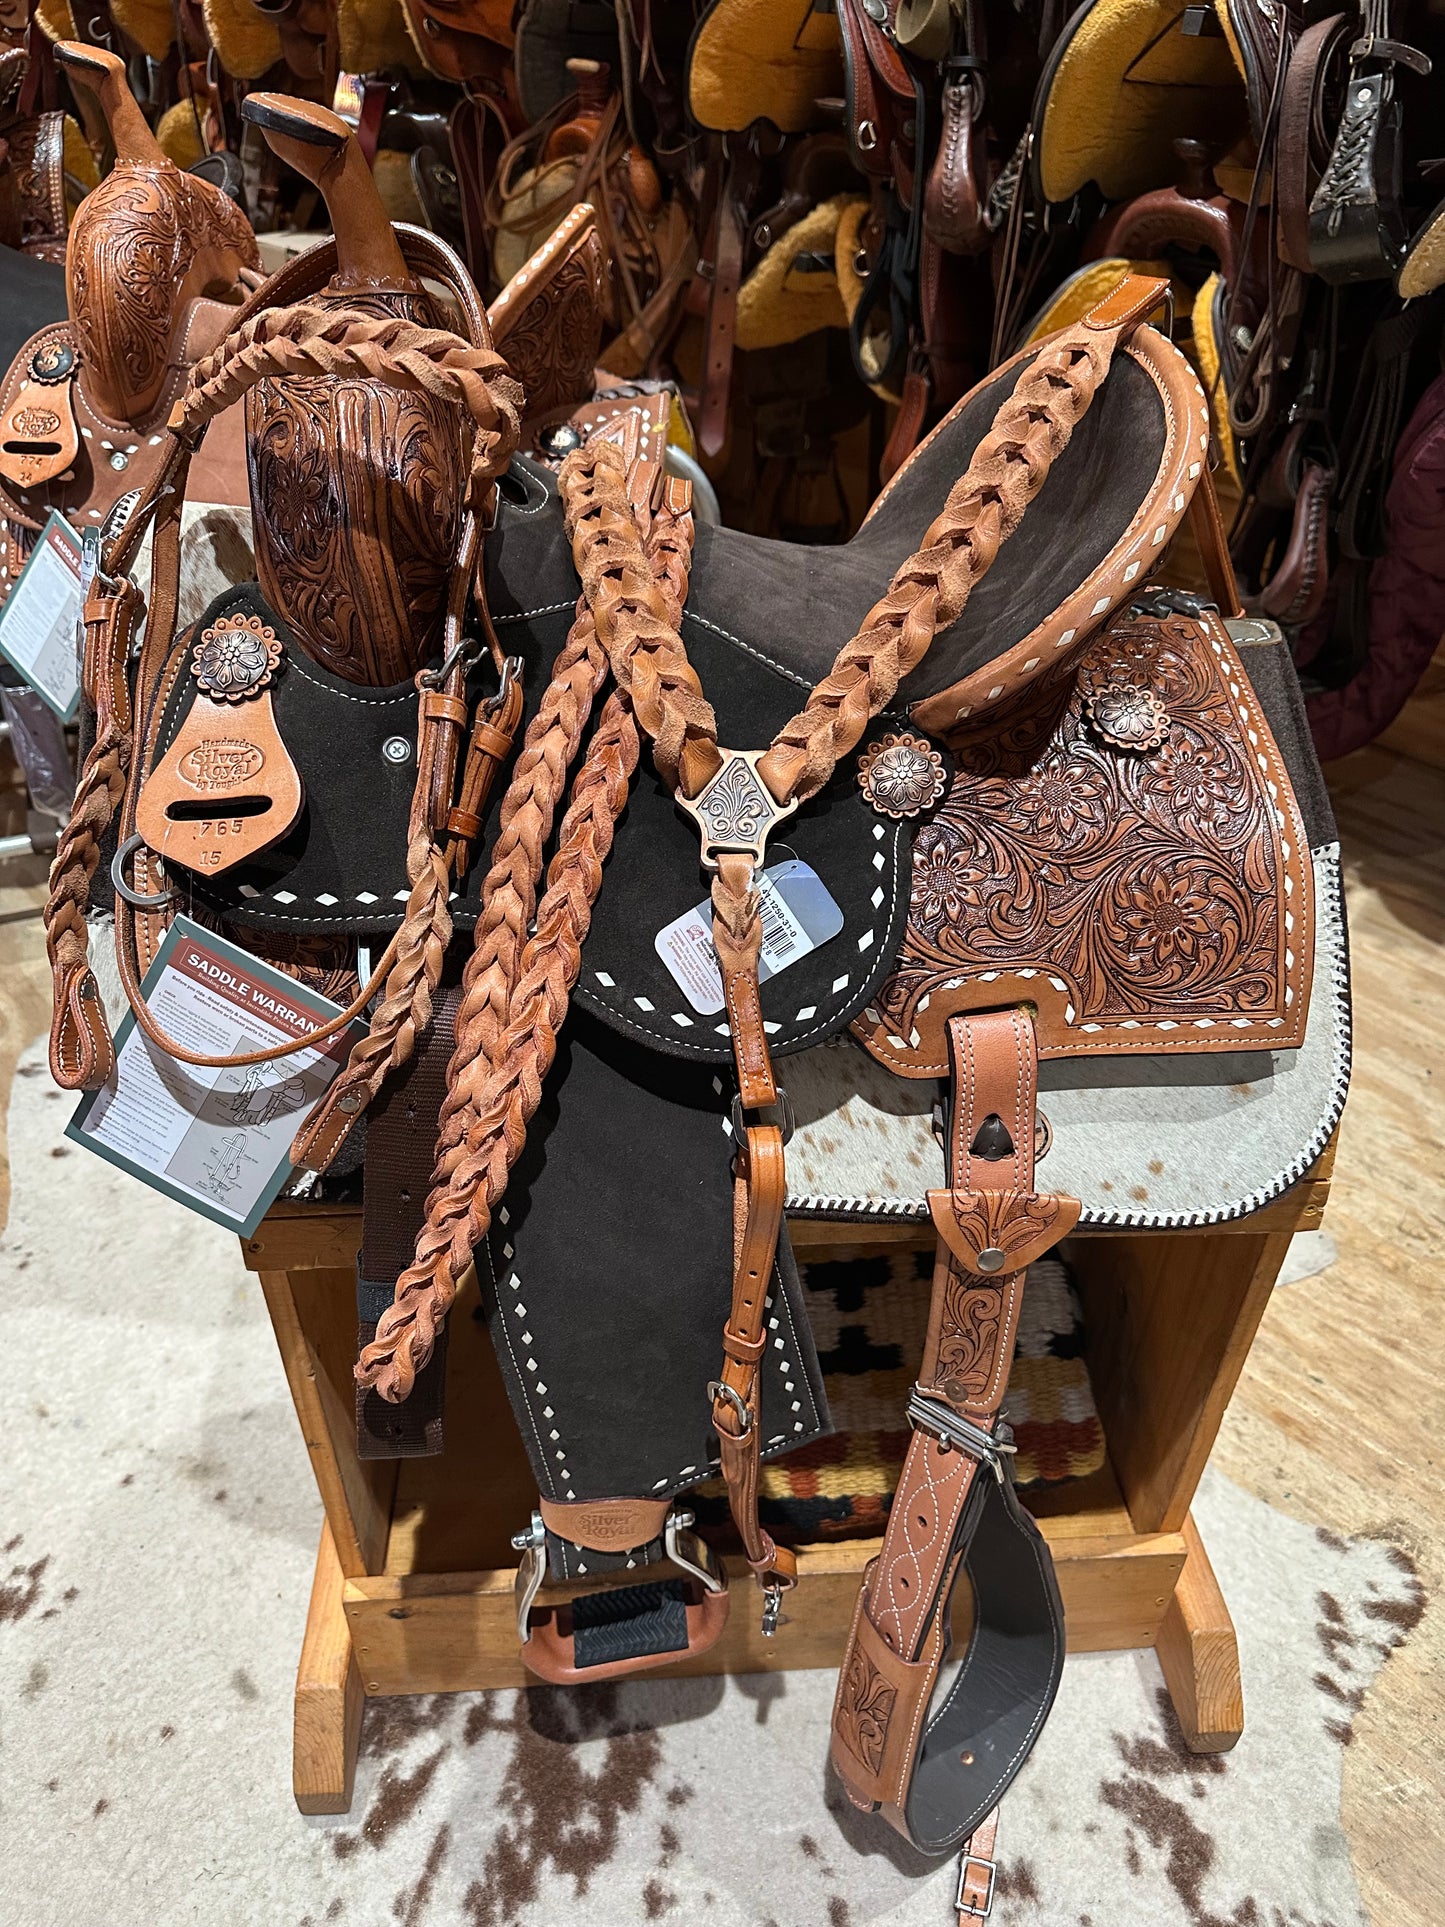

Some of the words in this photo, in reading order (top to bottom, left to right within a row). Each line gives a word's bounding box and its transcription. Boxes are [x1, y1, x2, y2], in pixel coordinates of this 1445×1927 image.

[52, 534, 79, 566] SADDLE
[191, 749, 255, 765] Silver
[197, 760, 252, 780] Royal
[199, 850, 222, 865] 15
[196, 971, 221, 989] Building
[219, 985, 240, 1001] Quality
[187, 953, 251, 996] SADDLE
[250, 989, 338, 1046] WARRANY
[578, 1513, 640, 1526] Silver
